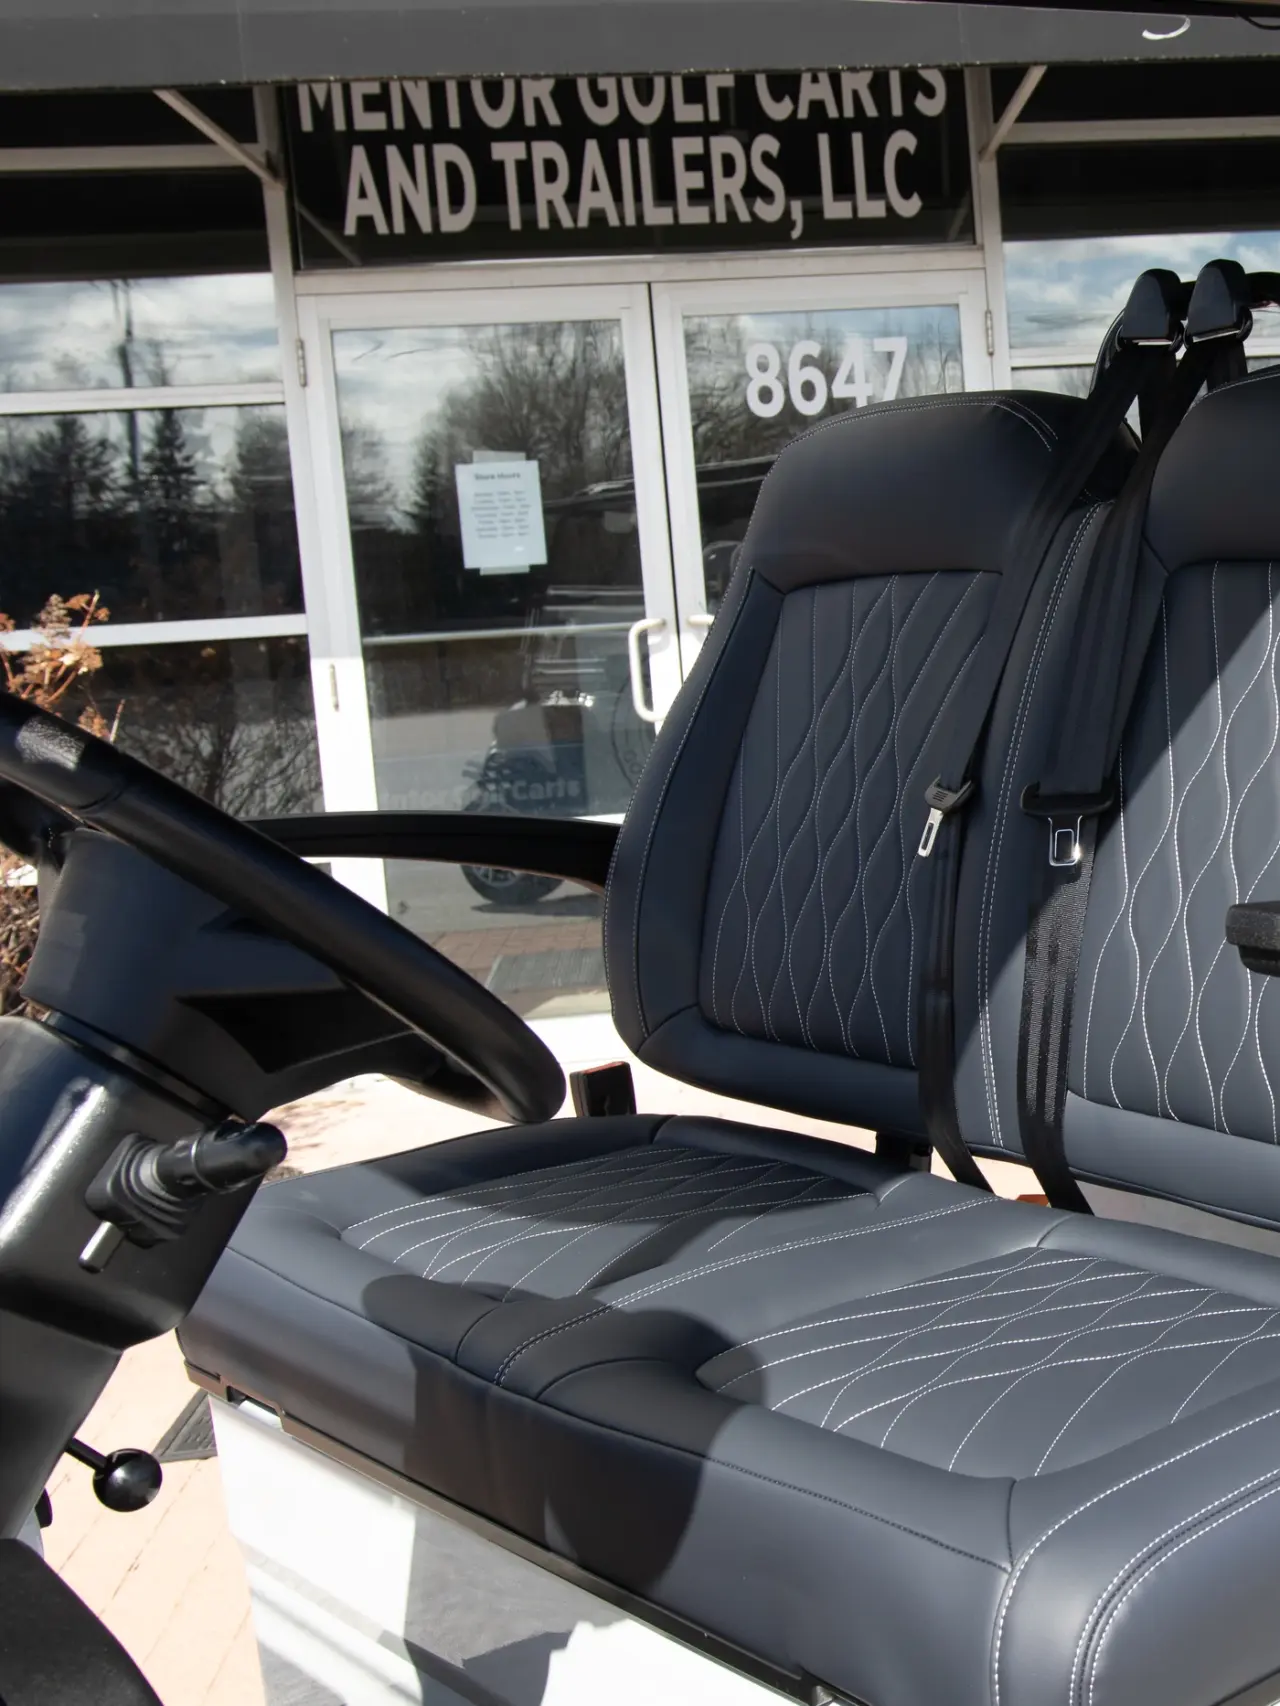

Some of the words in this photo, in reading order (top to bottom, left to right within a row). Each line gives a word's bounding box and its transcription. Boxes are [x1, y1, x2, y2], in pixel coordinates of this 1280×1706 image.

[344, 143, 477, 236] AND
[490, 132, 804, 240] TRAILERS,
[816, 129, 923, 219] LLC
[745, 336, 908, 418] 8647
